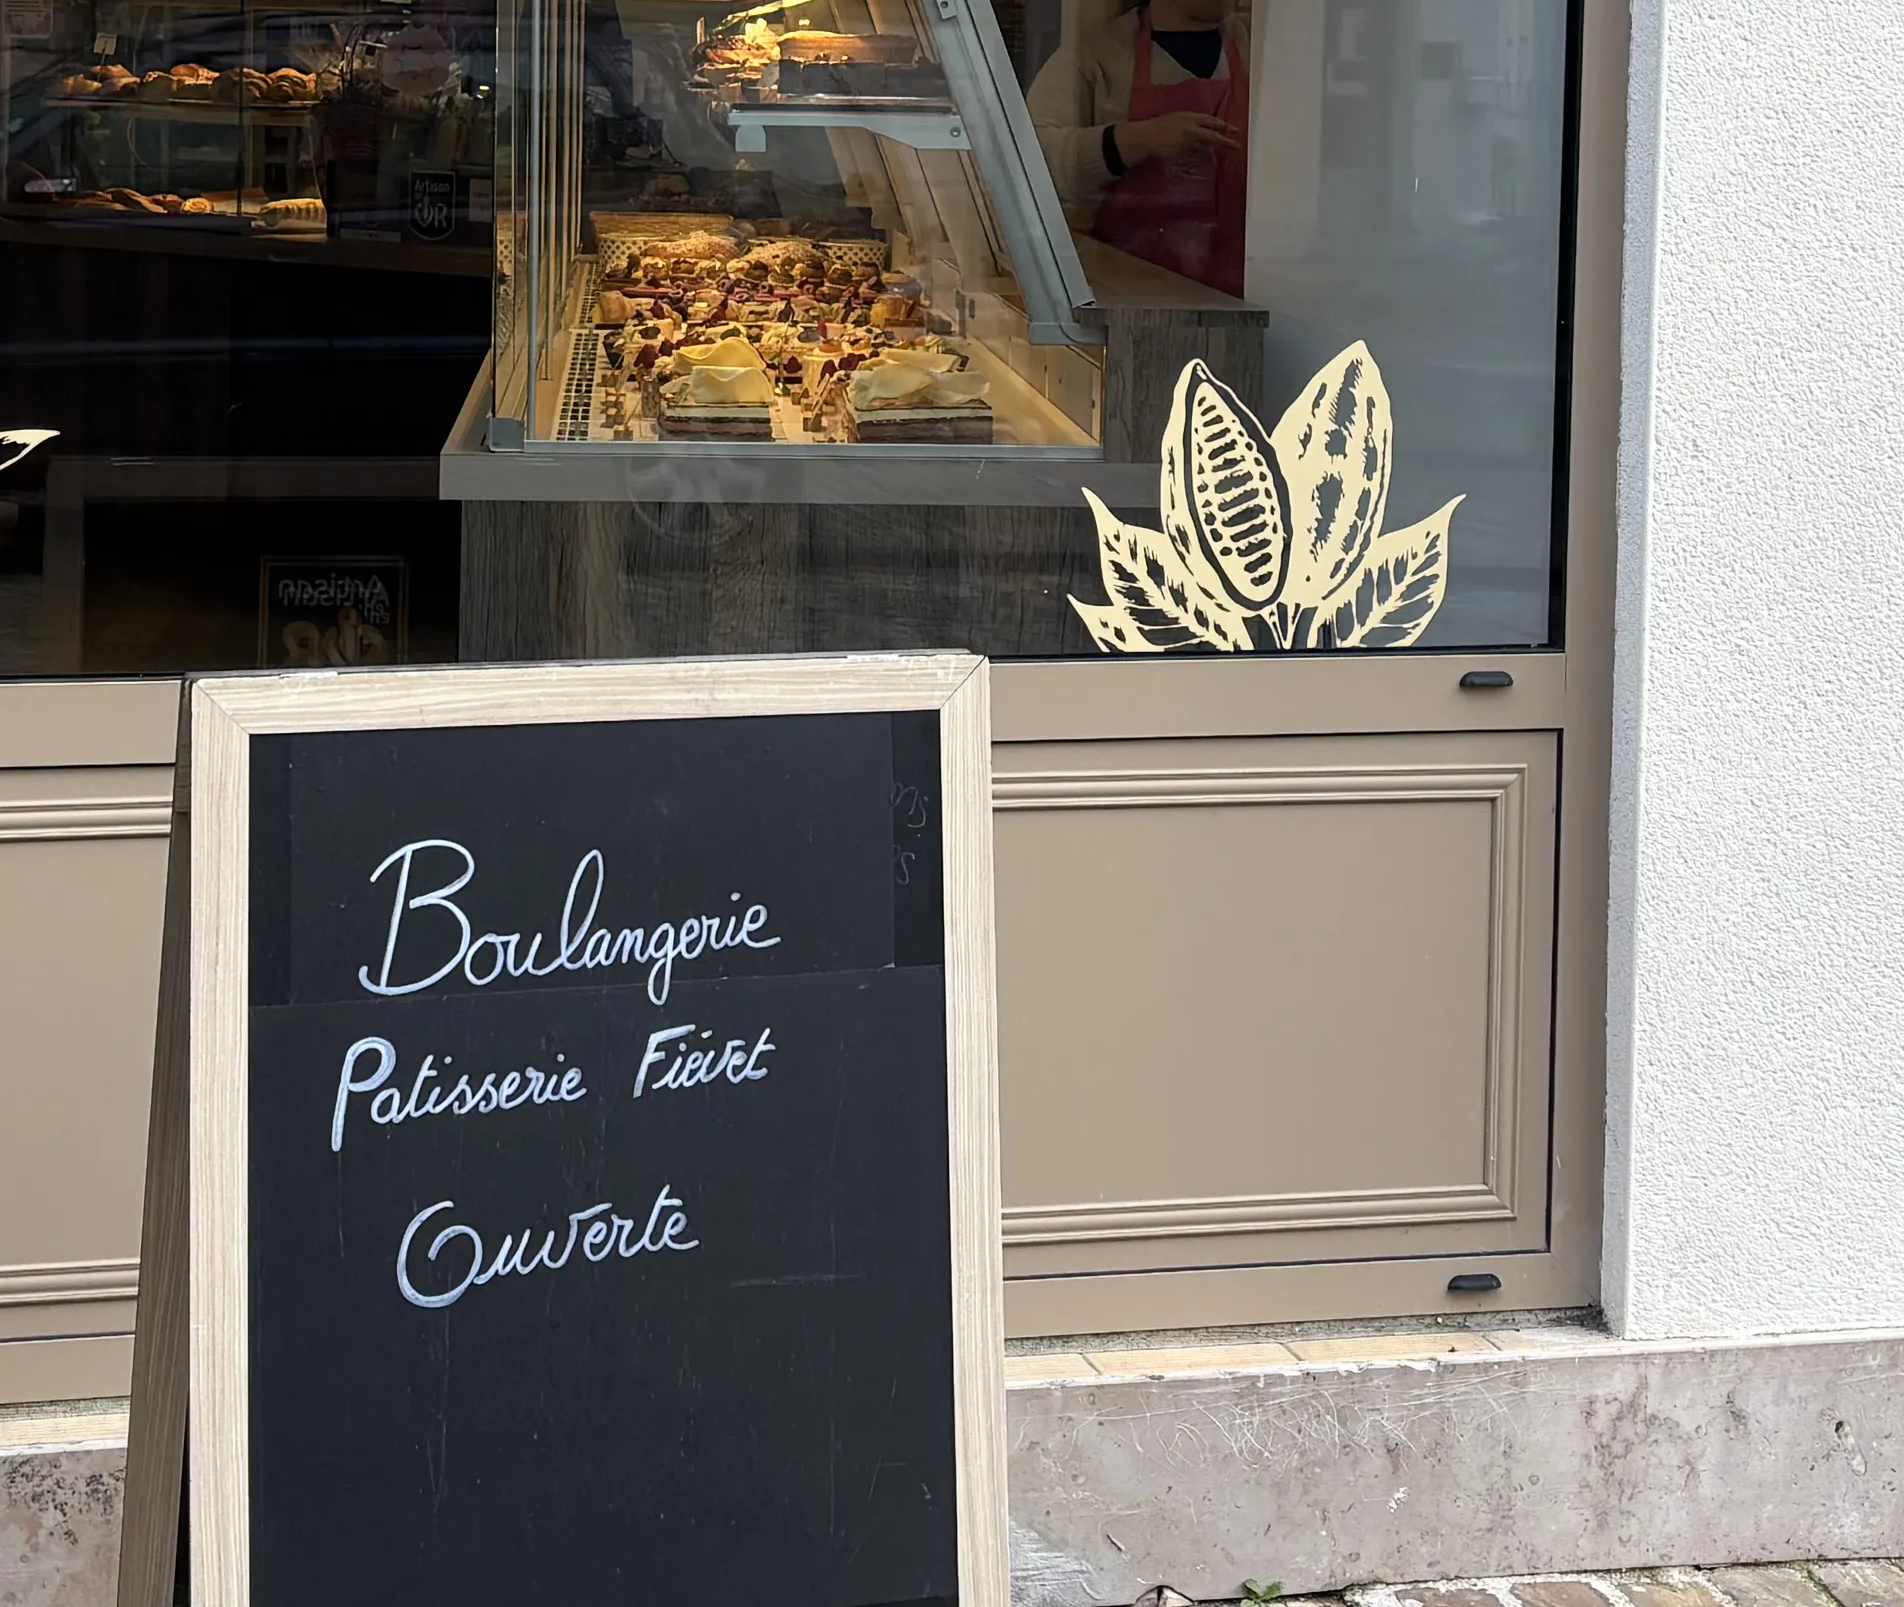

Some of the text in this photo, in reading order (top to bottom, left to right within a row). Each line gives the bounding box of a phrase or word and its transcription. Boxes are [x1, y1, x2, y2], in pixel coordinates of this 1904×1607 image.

[414, 178, 450, 192] Artisan
[359, 838, 782, 1005] Boulangerie
[331, 1035, 588, 1152] Patisserie
[395, 1183, 701, 1309] Ouverte
